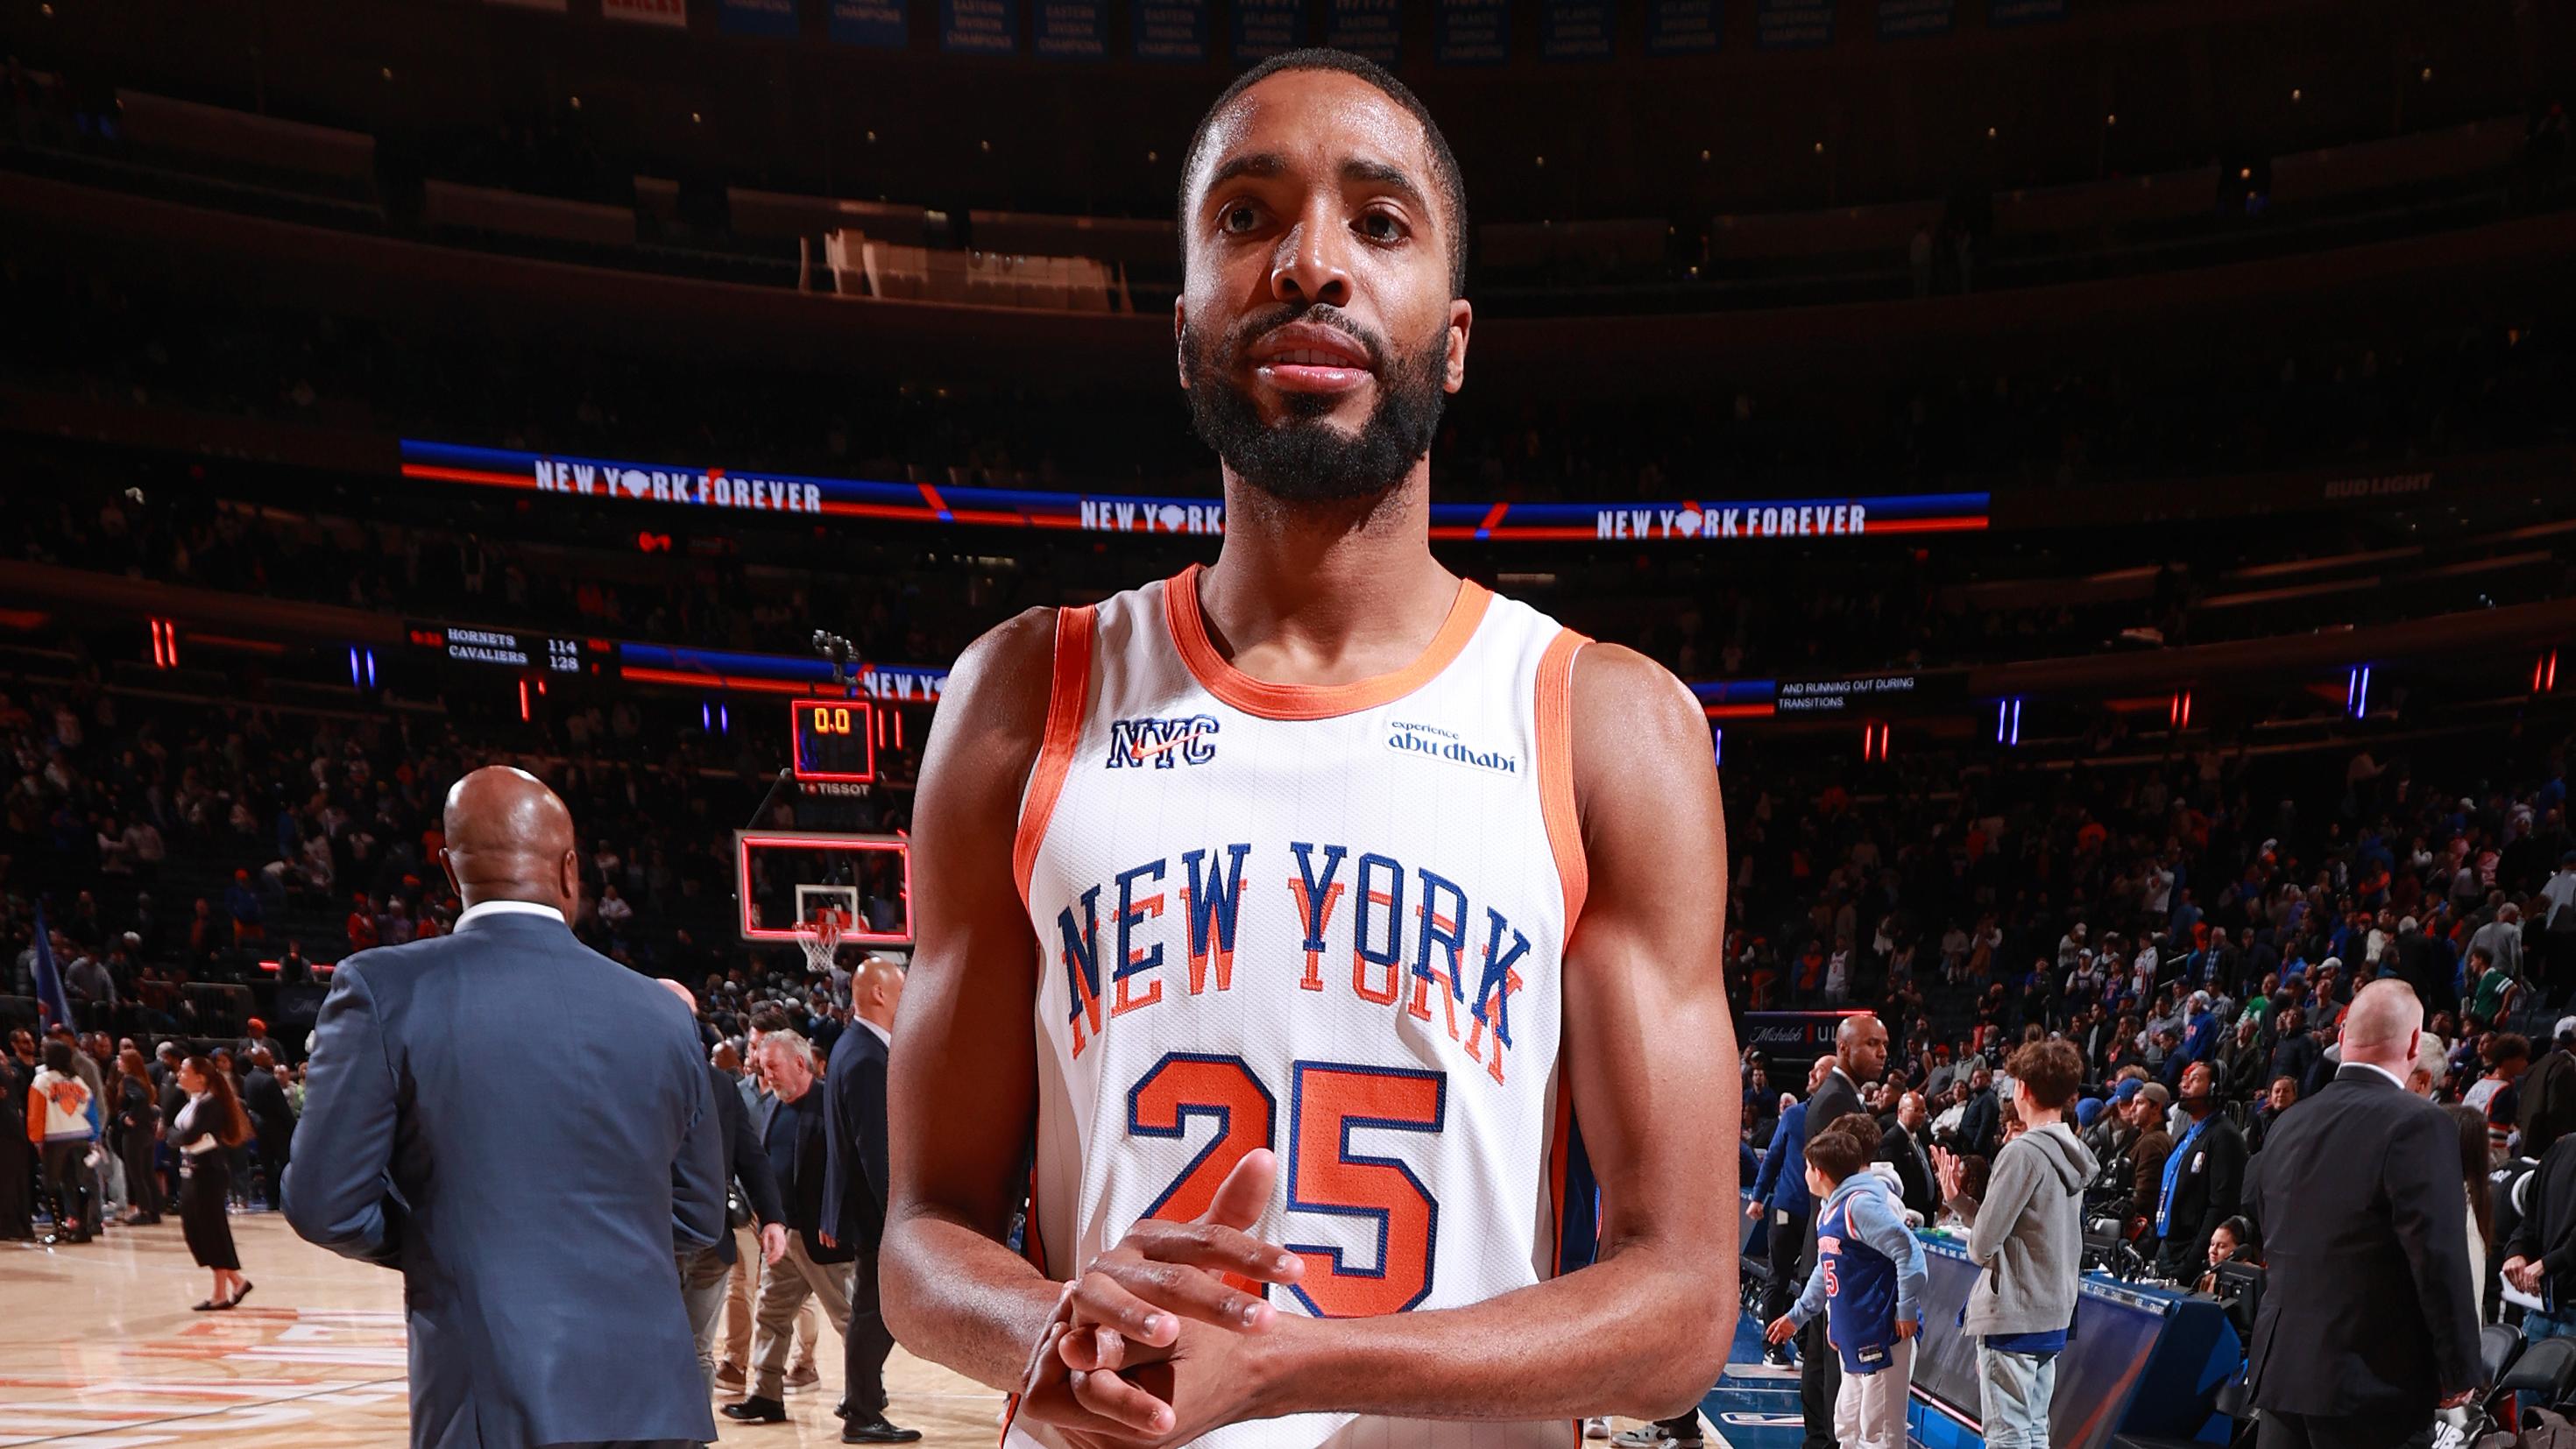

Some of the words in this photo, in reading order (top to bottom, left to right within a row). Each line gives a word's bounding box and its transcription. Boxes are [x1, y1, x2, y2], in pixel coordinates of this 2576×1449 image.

[534, 460, 595, 494] NEW
[698, 475, 821, 513] FOREVER
[2325, 478, 2369, 500] BUD
[2371, 472, 2434, 495] LIGHT
[1080, 500, 1135, 532] NEW
[1596, 509, 1652, 540] NEW
[1747, 505, 1865, 538] FOREVER
[447, 628, 515, 647] HORNETS
[548, 639, 577, 654] 114
[448, 646, 527, 665] CAVALIERS
[549, 655, 580, 673] 128
[863, 671, 913, 700] NEW
[1782, 683, 1804, 694] AND
[1805, 681, 1851, 693] RUNNING
[1852, 679, 1874, 691] OUT
[1876, 677, 1914, 689] DURING
[815, 708, 851, 734] 0.0
[1391, 721, 1459, 739] experience
[1106, 715, 1219, 769] NYC
[1388, 732, 1438, 756] abu
[1443, 743, 1516, 774] dhabi
[817, 782, 870, 795] TISSOT
[1058, 844, 1251, 1058] NEW
[1287, 842, 1532, 1085] YORK
[1749, 1023, 1803, 1043] Michelob
[1127, 1051, 1447, 1319] 25
